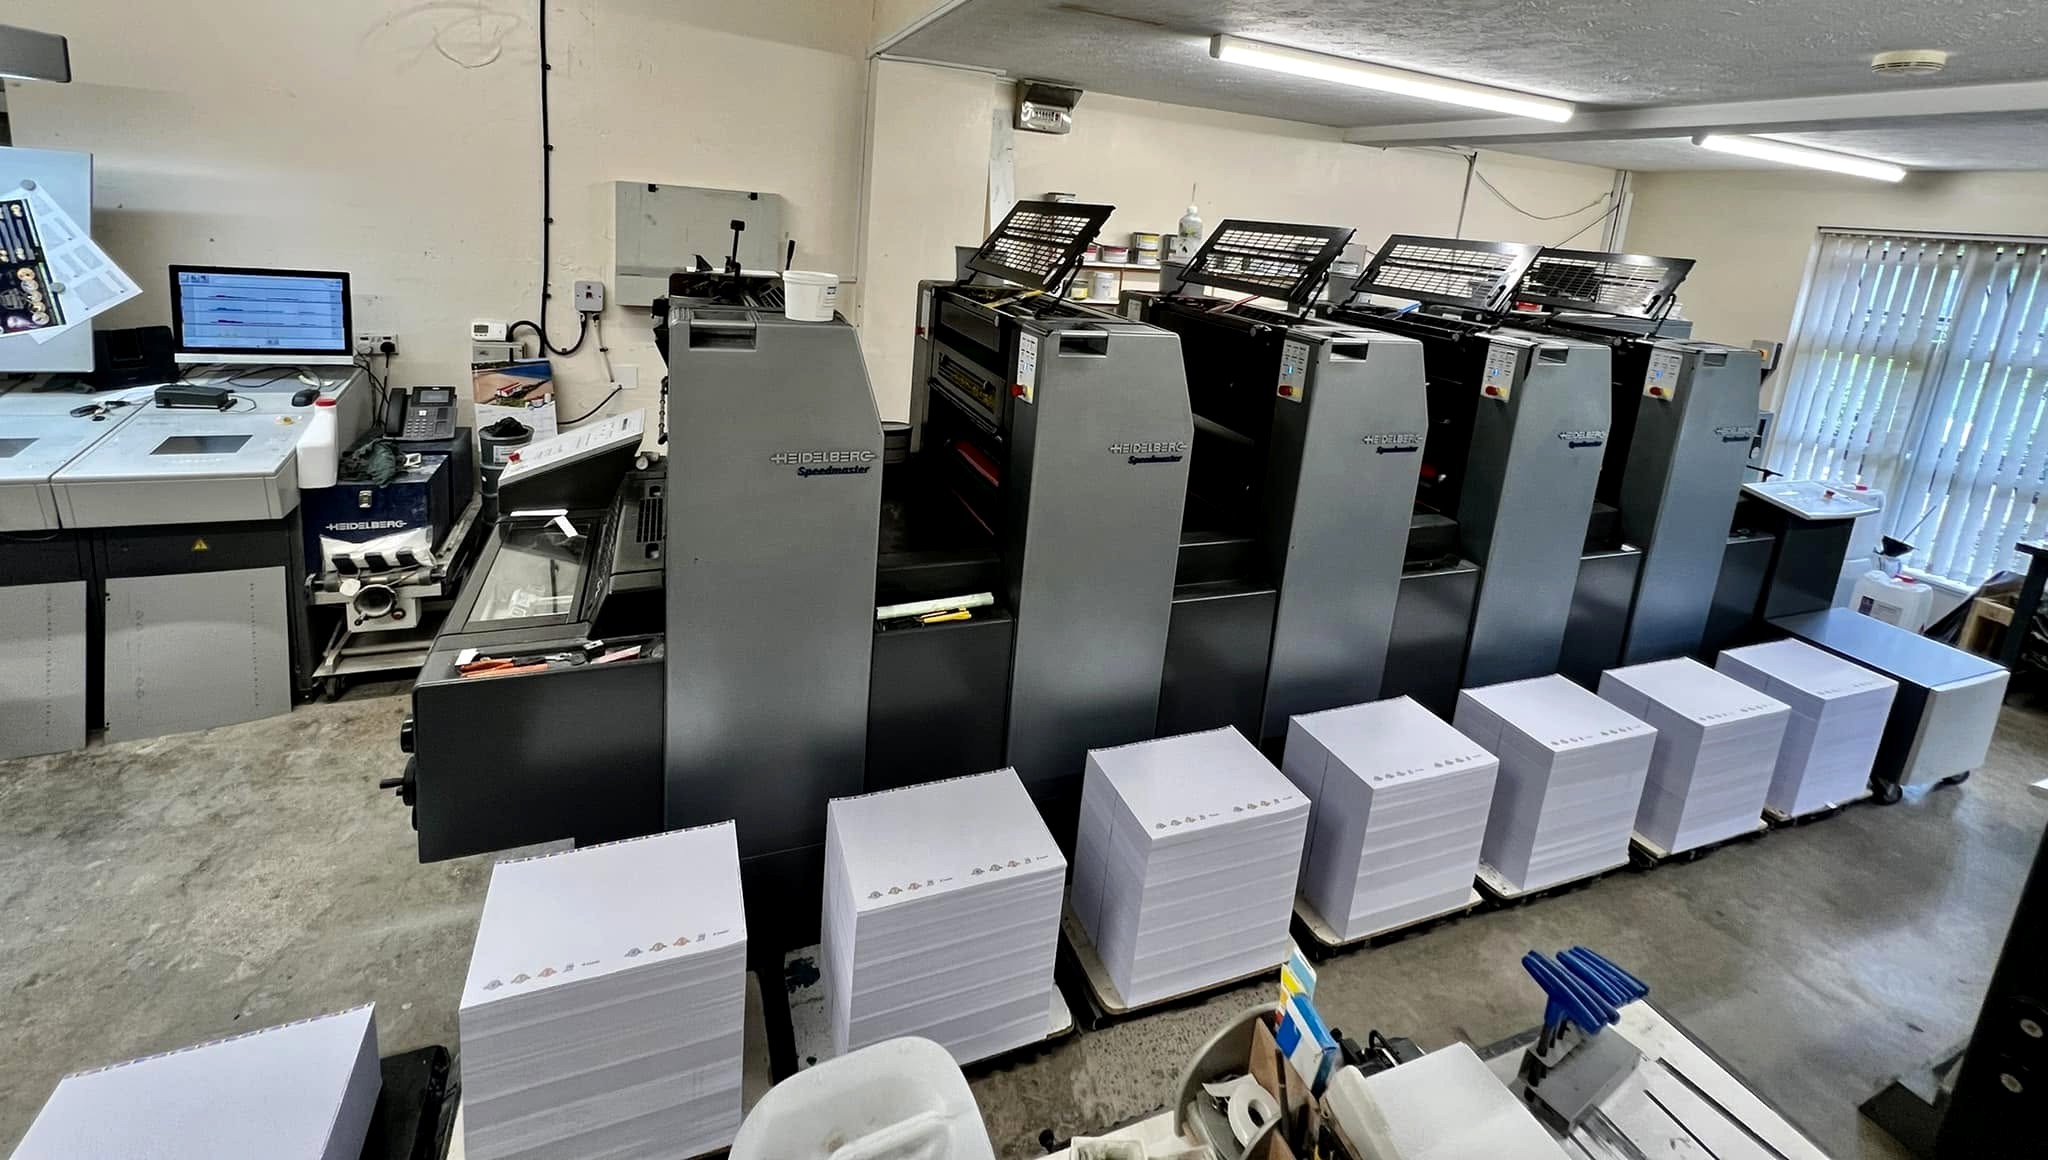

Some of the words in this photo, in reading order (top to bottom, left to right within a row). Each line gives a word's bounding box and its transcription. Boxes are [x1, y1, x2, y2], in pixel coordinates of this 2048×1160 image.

[1110, 442, 1188, 454] HEIDELBERG
[770, 451, 876, 464] HEIDELBERG
[797, 465, 870, 478] Speedmaster
[325, 520, 408, 531] HEIDELBERG
